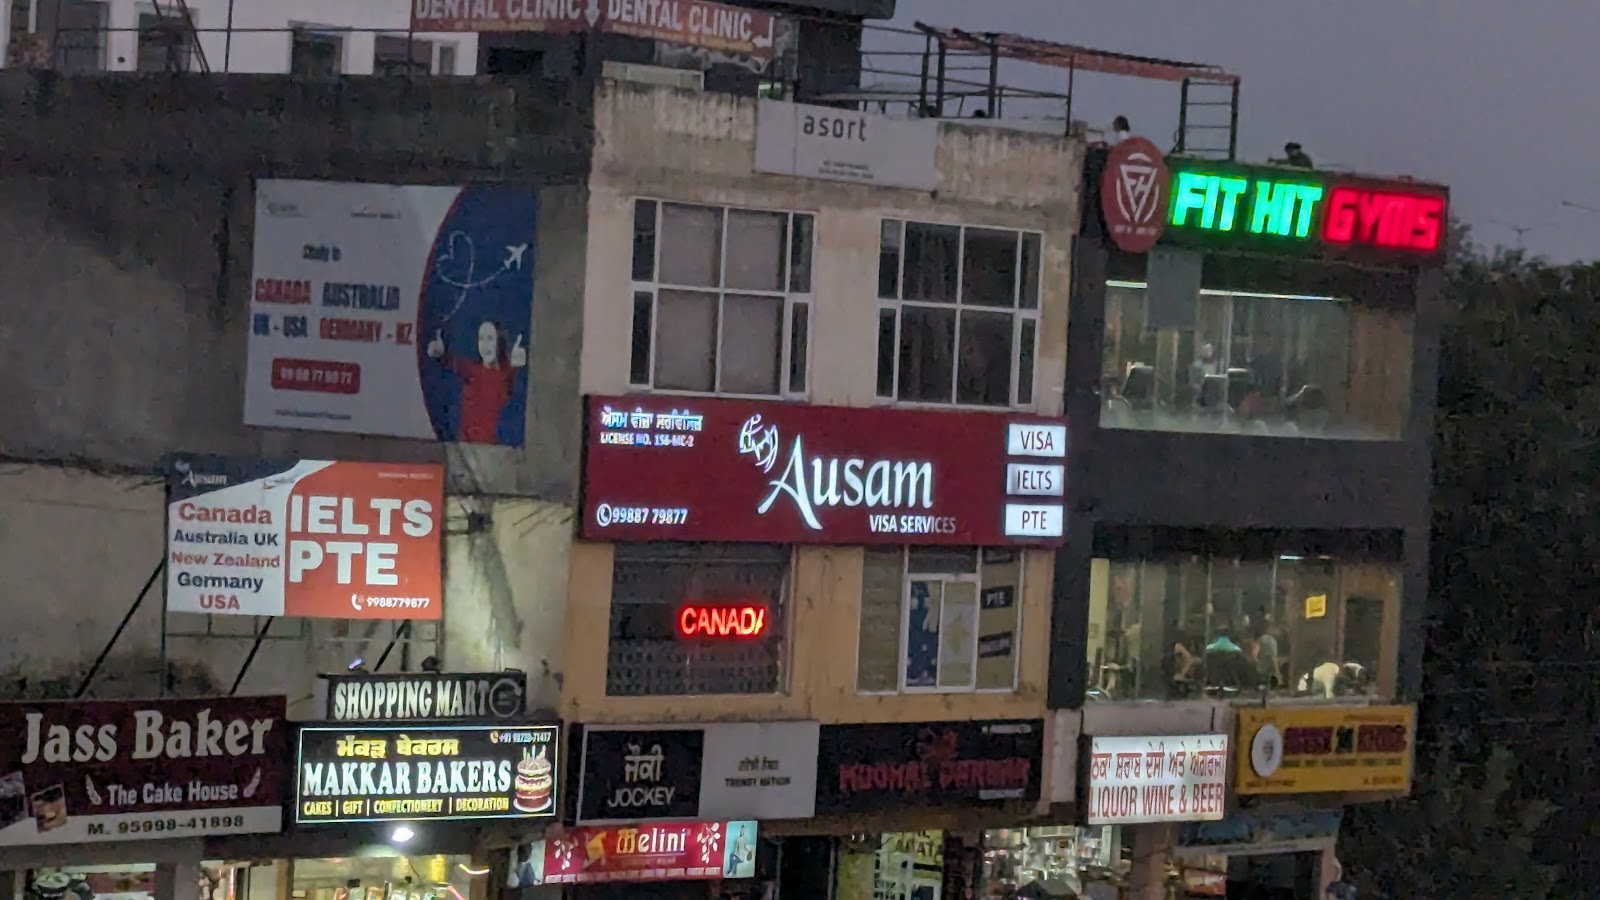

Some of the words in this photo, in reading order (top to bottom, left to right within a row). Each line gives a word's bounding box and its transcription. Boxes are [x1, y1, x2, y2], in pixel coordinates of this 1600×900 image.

[415, 0, 499, 19] DENTAL
[507, 0, 581, 20] CLINIC
[608, 0, 682, 31] DENTAL
[688, 5, 752, 41] CLINIC
[803, 114, 867, 142] asort
[1172, 171, 1247, 232] FIT
[1251, 179, 1323, 239] HIT
[1326, 187, 1444, 250] GYMS
[322, 282, 399, 311] AUSTRALIA
[283, 315, 308, 338] USA
[600, 432, 635, 445] LICENSE
[1020, 430, 1054, 451] VISA
[757, 433, 934, 530] Ausam
[1017, 469, 1053, 491] IELTS
[179, 502, 272, 525] Canada
[290, 494, 434, 538] IELTS
[612, 507, 650, 524] 99887
[651, 508, 689, 525] 79877
[869, 513, 898, 534] VISA
[900, 515, 957, 535] SERVICES
[1021, 510, 1048, 531] PTE
[173, 529, 248, 546] Australia
[254, 533, 278, 548] UK
[171, 551, 208, 566] New
[213, 552, 281, 569] Zealand
[289, 540, 399, 586] PTE
[177, 571, 264, 593] Germany
[199, 595, 241, 610] USA
[366, 596, 431, 609] 9988779877
[334, 680, 433, 720] SHOPPING
[435, 680, 490, 717] MART
[21, 712, 118, 765] Jass
[132, 707, 274, 760] Baker
[302, 761, 412, 797] MAKKAR
[416, 760, 512, 794] BAKERS
[107, 783, 138, 806] The
[142, 781, 183, 804] Cake
[187, 780, 239, 802] House
[607, 786, 676, 808] JOCKEY
[1088, 785, 1138, 819] LIQUOR
[1142, 784, 1175, 817] WINE
[1179, 784, 1188, 814] &
[1192, 782, 1224, 814] BEER
[342, 800, 363, 815] GIFT
[455, 796, 510, 813] DECORATION
[616, 827, 687, 854] Melini
